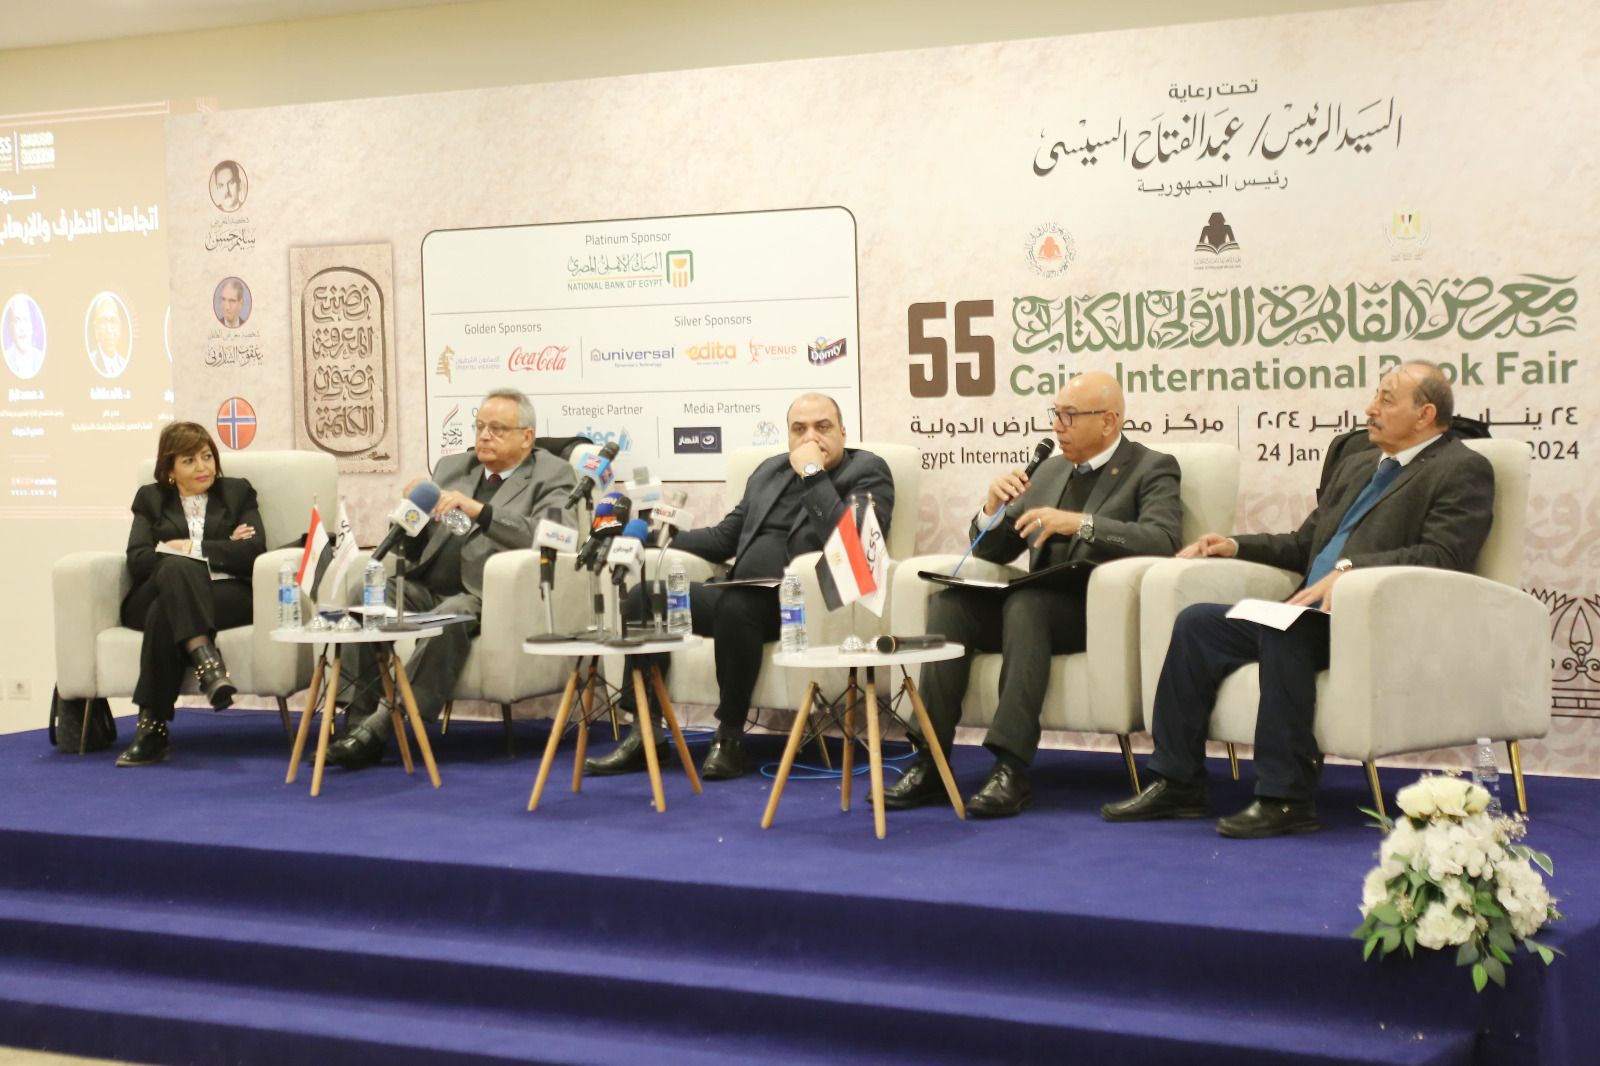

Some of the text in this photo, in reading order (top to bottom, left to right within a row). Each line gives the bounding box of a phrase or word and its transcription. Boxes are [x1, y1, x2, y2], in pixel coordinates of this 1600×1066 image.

[1168, 79, 1259, 101] تحت رعاية
[1137, 171, 1289, 197] رئيس الجمهورية
[585, 232, 672, 246] Platinum Sponsor
[567, 278, 663, 291] NATIONAL BANK OF EGYPT
[464, 322, 542, 336] Golden Sponsors
[674, 314, 752, 329] Silver Sponsors
[602, 347, 675, 361] universal
[687, 341, 737, 360] edita
[764, 344, 798, 355] VENUS
[810, 342, 844, 361] Domty
[907, 299, 996, 398] 55
[1009, 364, 1083, 396] Cai
[1115, 355, 1367, 393] International
[1496, 351, 1578, 385] Fair
[562, 404, 644, 419] Strategic Partner
[683, 402, 761, 415] Media Partners
[1551, 406, 1579, 426] ٢٤
[910, 415, 984, 439] الدولية
[1122, 419, 1152, 433] مص
[1162, 413, 1224, 435] مركز
[1257, 410, 1300, 429] ٢٠٢٤
[918, 446, 1031, 470] gypt Internati
[1257, 442, 1282, 463] 24
